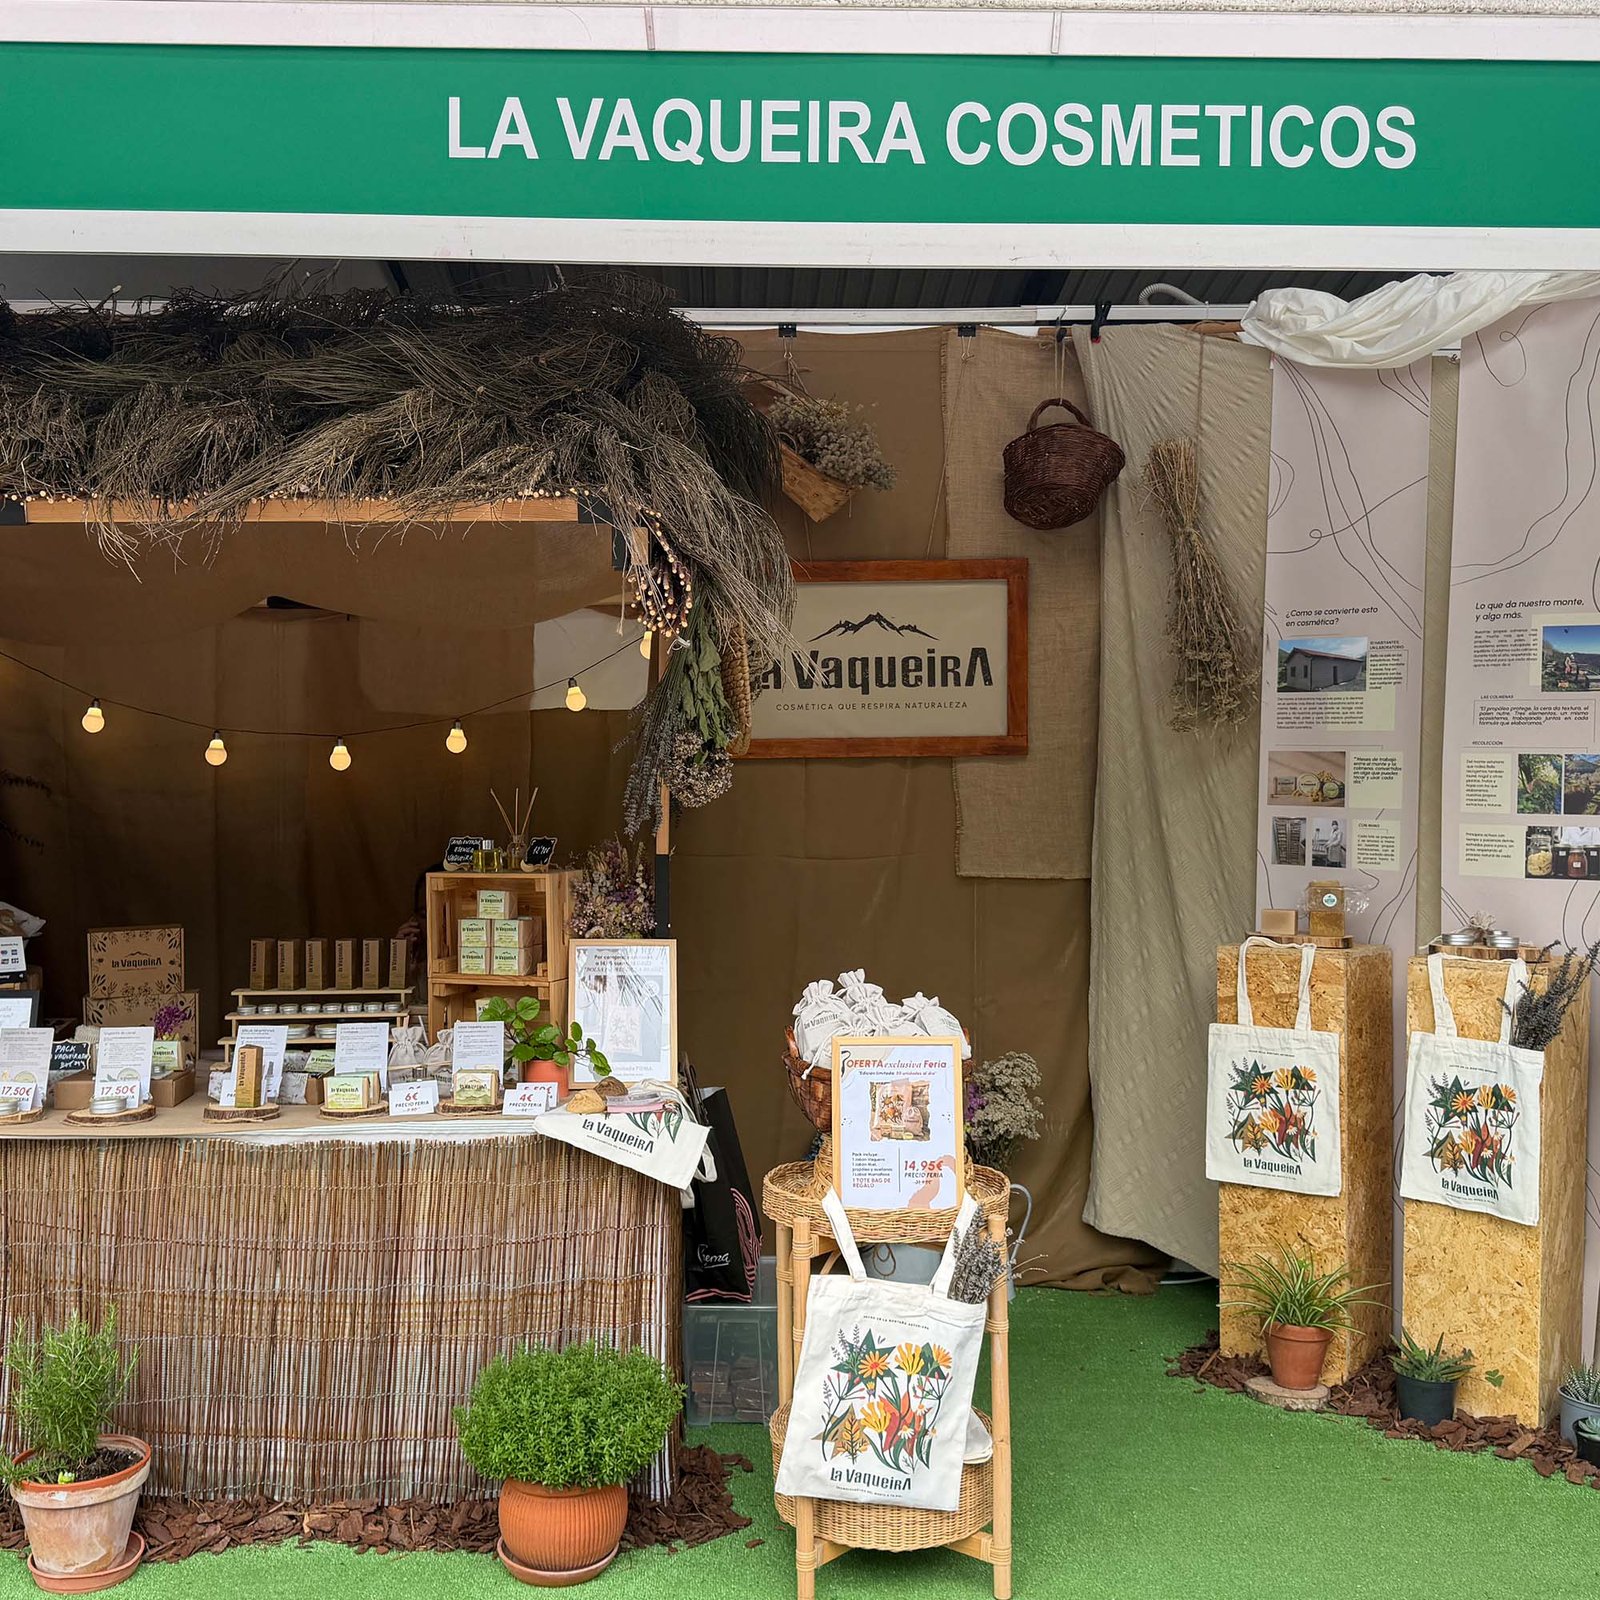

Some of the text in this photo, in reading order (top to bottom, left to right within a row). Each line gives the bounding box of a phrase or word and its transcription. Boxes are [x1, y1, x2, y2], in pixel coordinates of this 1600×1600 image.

[448, 96, 1417, 170] LA VAQUEIRA COSMETICOS
[1487, 602, 1503, 611] que
[1505, 600, 1517, 608] da
[1519, 600, 1551, 608] nuestro
[1324, 607, 1359, 615] convierte
[1482, 612, 1501, 622] algo
[1296, 618, 1339, 626] cosmética?
[776, 702, 833, 711] COSMÉTICA
[904, 701, 968, 710] NATURALEZA
[846, 1060, 884, 1068] OFERTA
[884, 1060, 921, 1068] exclusiva
[405, 1092, 418, 1101] 6€
[519, 1094, 534, 1102] 4€
